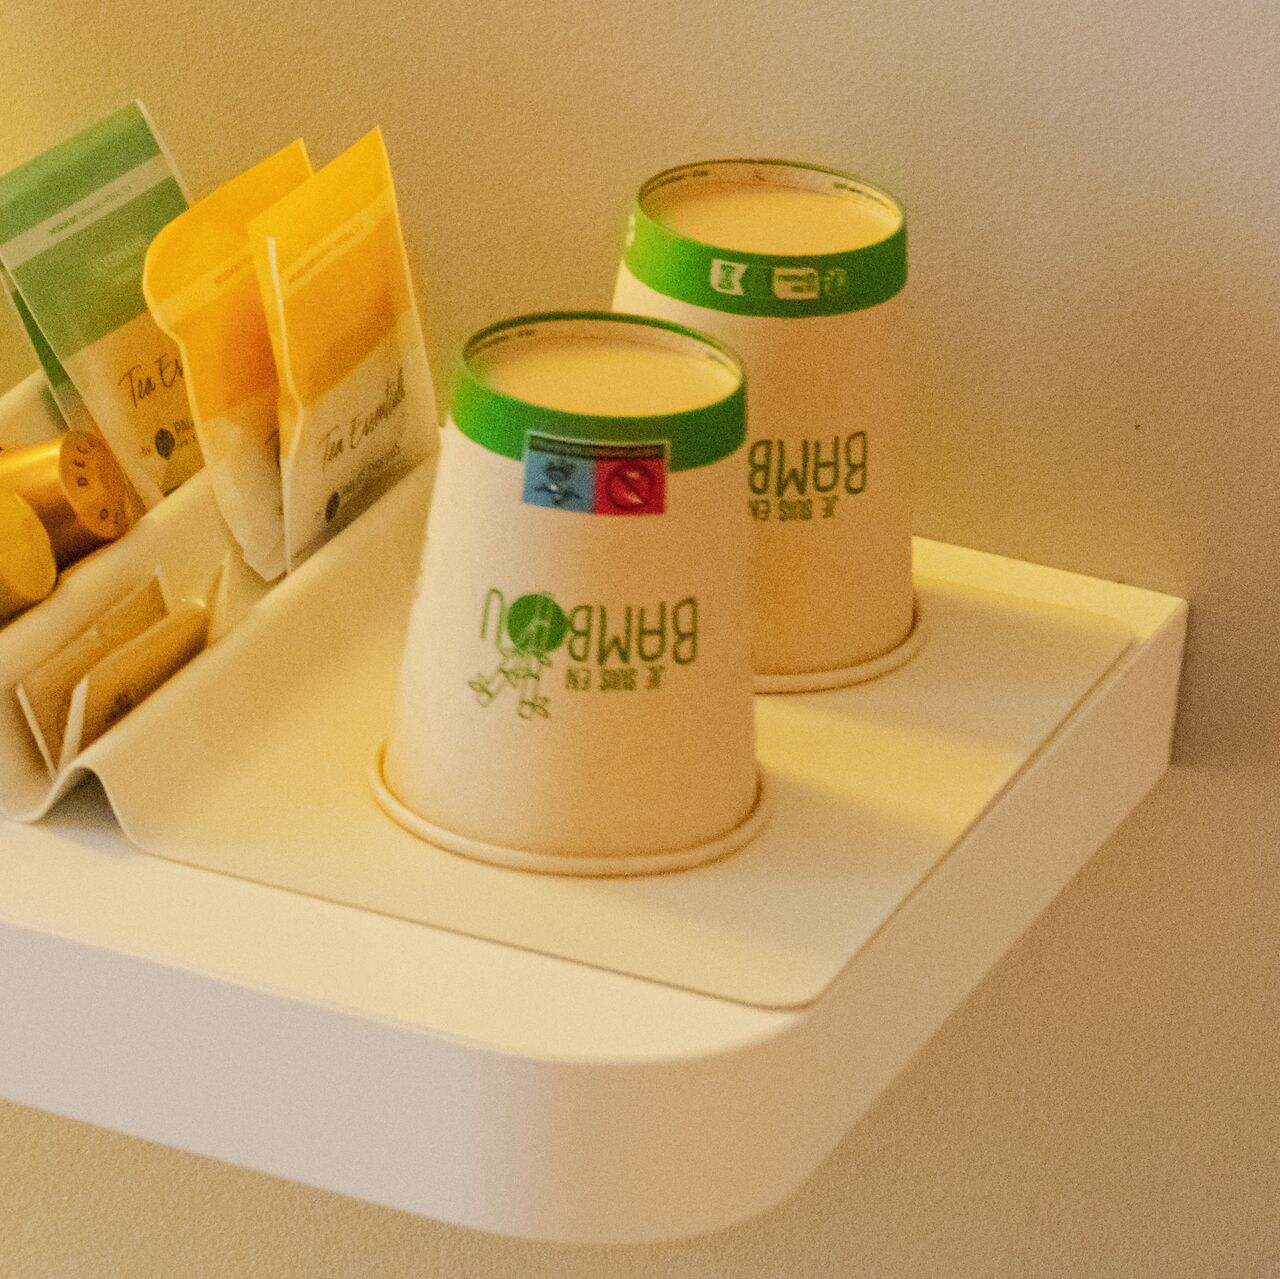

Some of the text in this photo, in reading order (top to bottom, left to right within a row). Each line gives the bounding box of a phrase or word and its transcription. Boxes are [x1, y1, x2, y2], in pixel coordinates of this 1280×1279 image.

[118, 364, 156, 409] Tea
[317, 425, 344, 472] Tea
[748, 430, 867, 498] BAMB
[778, 498, 813, 521] SUIS
[821, 494, 839, 519] JE
[565, 665, 665, 691] JE SUIS EN
